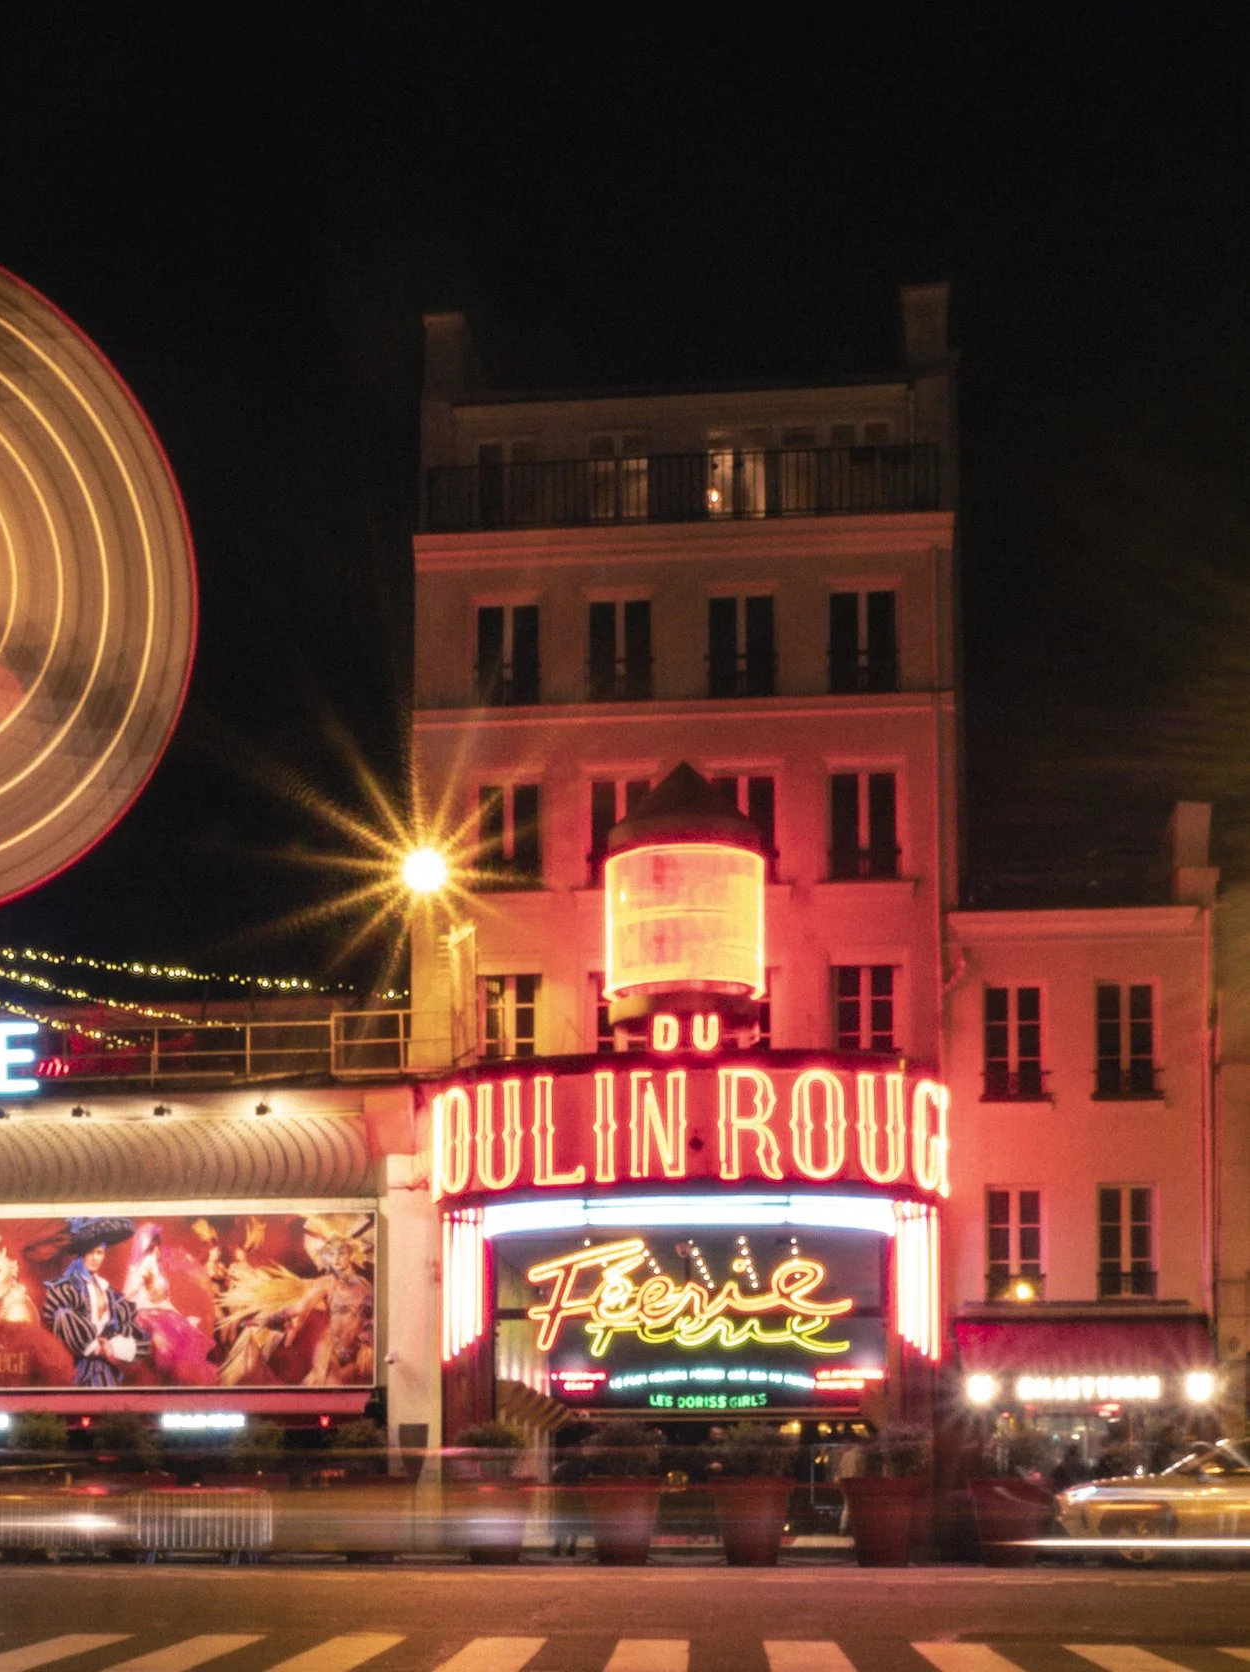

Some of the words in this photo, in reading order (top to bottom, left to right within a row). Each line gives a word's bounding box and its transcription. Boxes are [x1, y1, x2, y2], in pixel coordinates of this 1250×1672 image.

[653, 1014, 719, 1051] DU
[432, 1070, 687, 1203] OULIN
[717, 1067, 950, 1198] ROUG
[650, 1394, 673, 1408] LES
